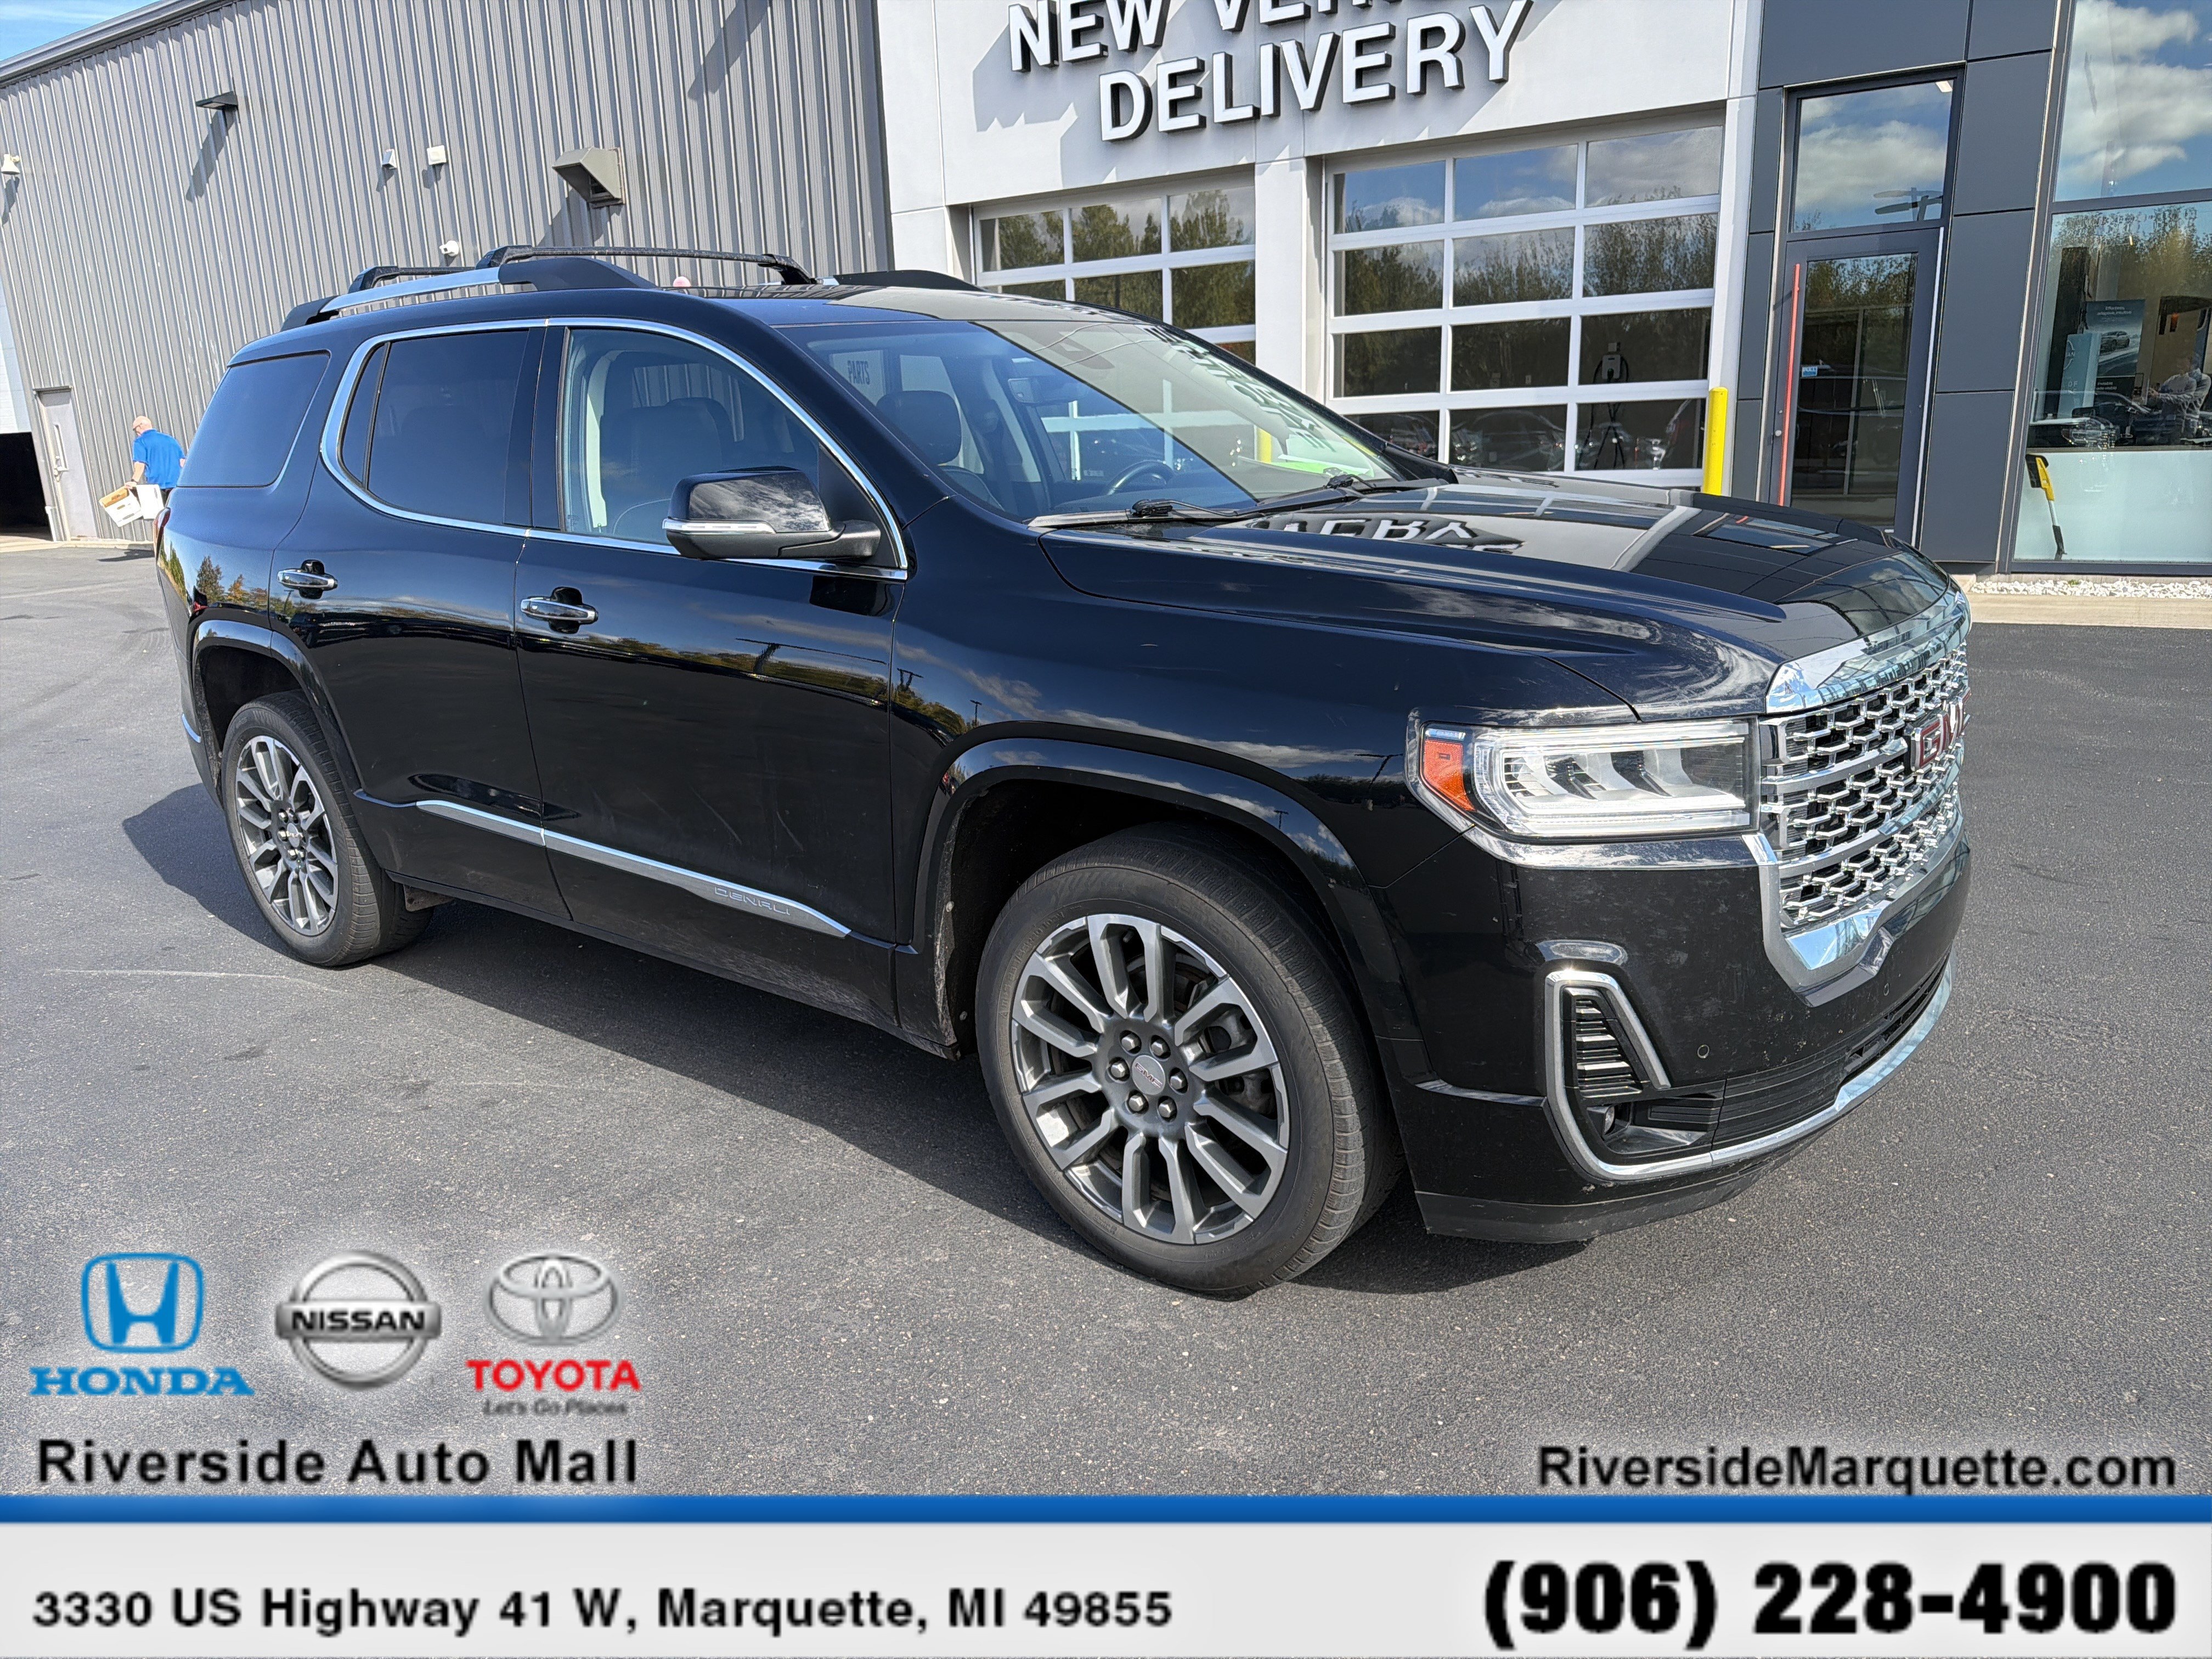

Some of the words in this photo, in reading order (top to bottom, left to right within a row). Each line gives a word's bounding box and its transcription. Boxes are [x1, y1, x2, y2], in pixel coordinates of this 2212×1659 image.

[1008, 0, 1169, 72] NEW
[1099, 0, 1534, 142] DELIVERY
[847, 360, 870, 385] PARTS
[1912, 687, 1971, 769] GMC
[714, 885, 791, 916] DENALI
[1135, 1062, 1163, 1089] GMC
